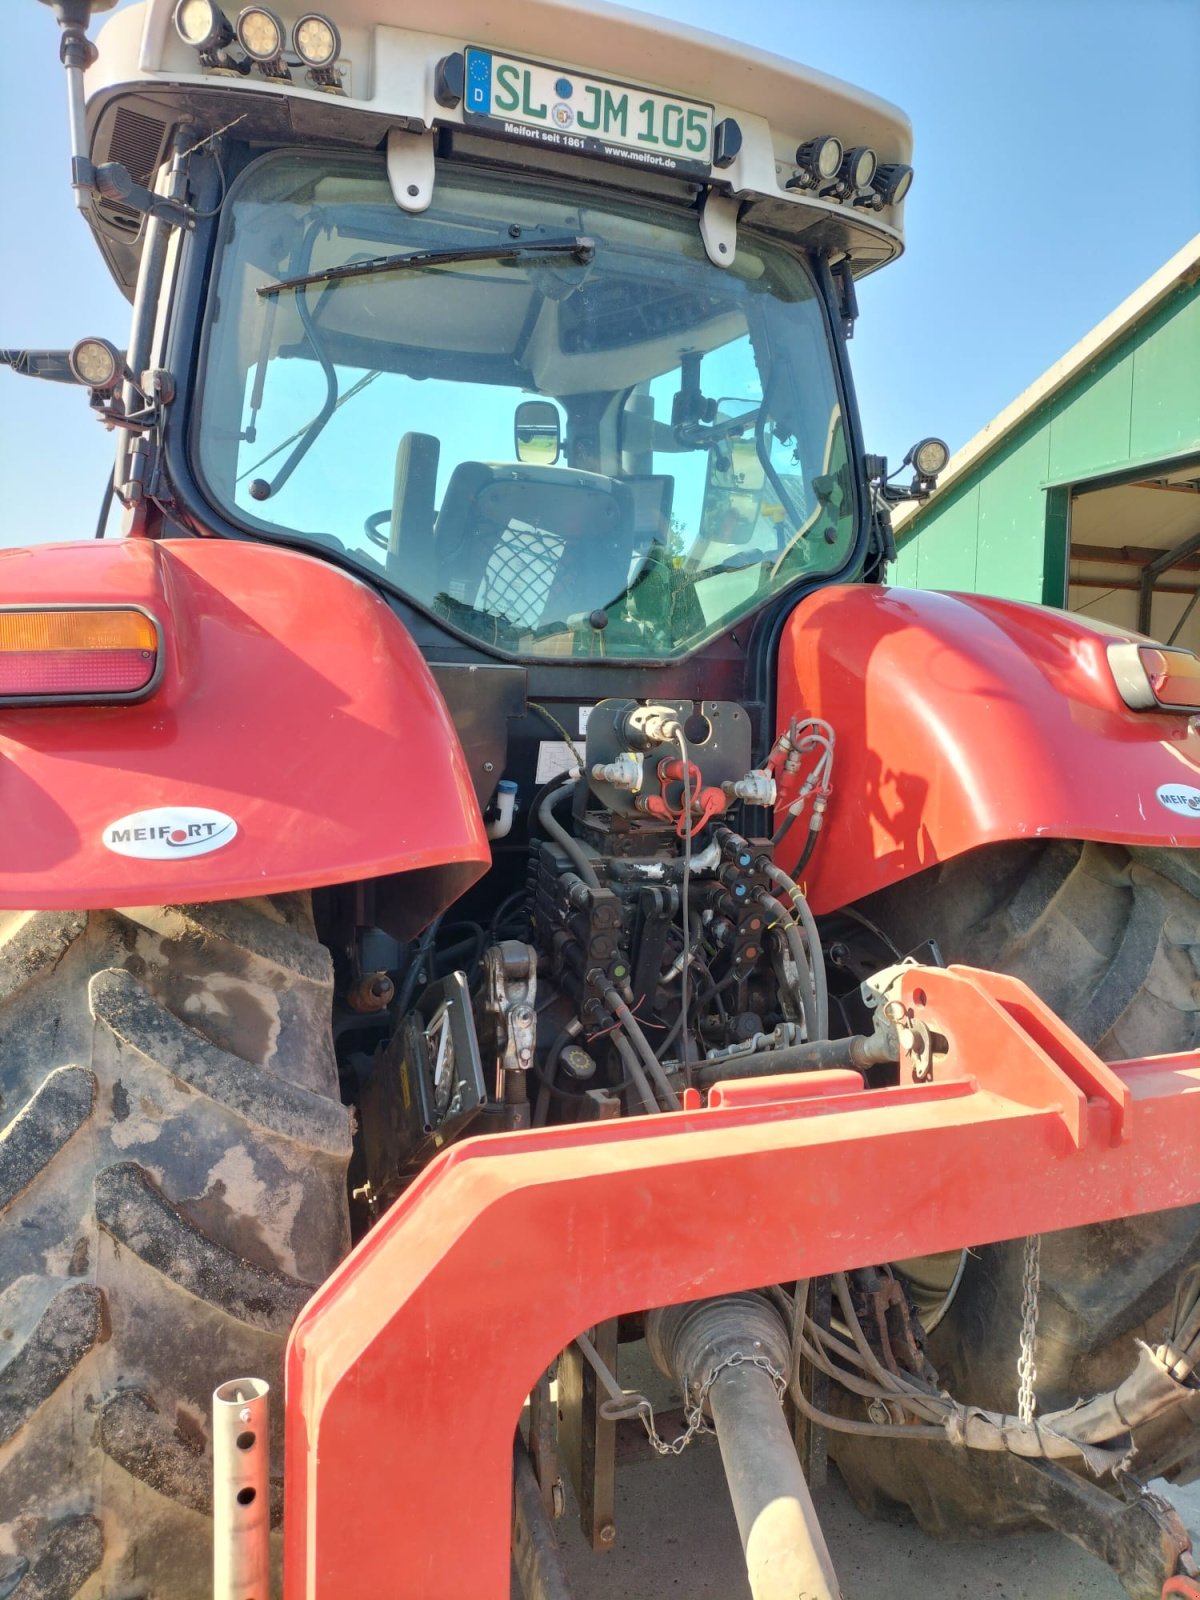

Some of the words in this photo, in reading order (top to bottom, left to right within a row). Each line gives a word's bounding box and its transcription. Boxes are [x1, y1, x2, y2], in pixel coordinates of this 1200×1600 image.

[474, 88, 483, 102] D
[494, 65, 547, 120] SL
[576, 85, 629, 137] JM
[637, 100, 708, 153] 105
[504, 123, 540, 139] Meifort
[542, 131, 561, 145] seit
[562, 136, 585, 149] 1861
[604, 146, 676, 169] www.meifort.de
[111, 822, 216, 843] MEIFORT
